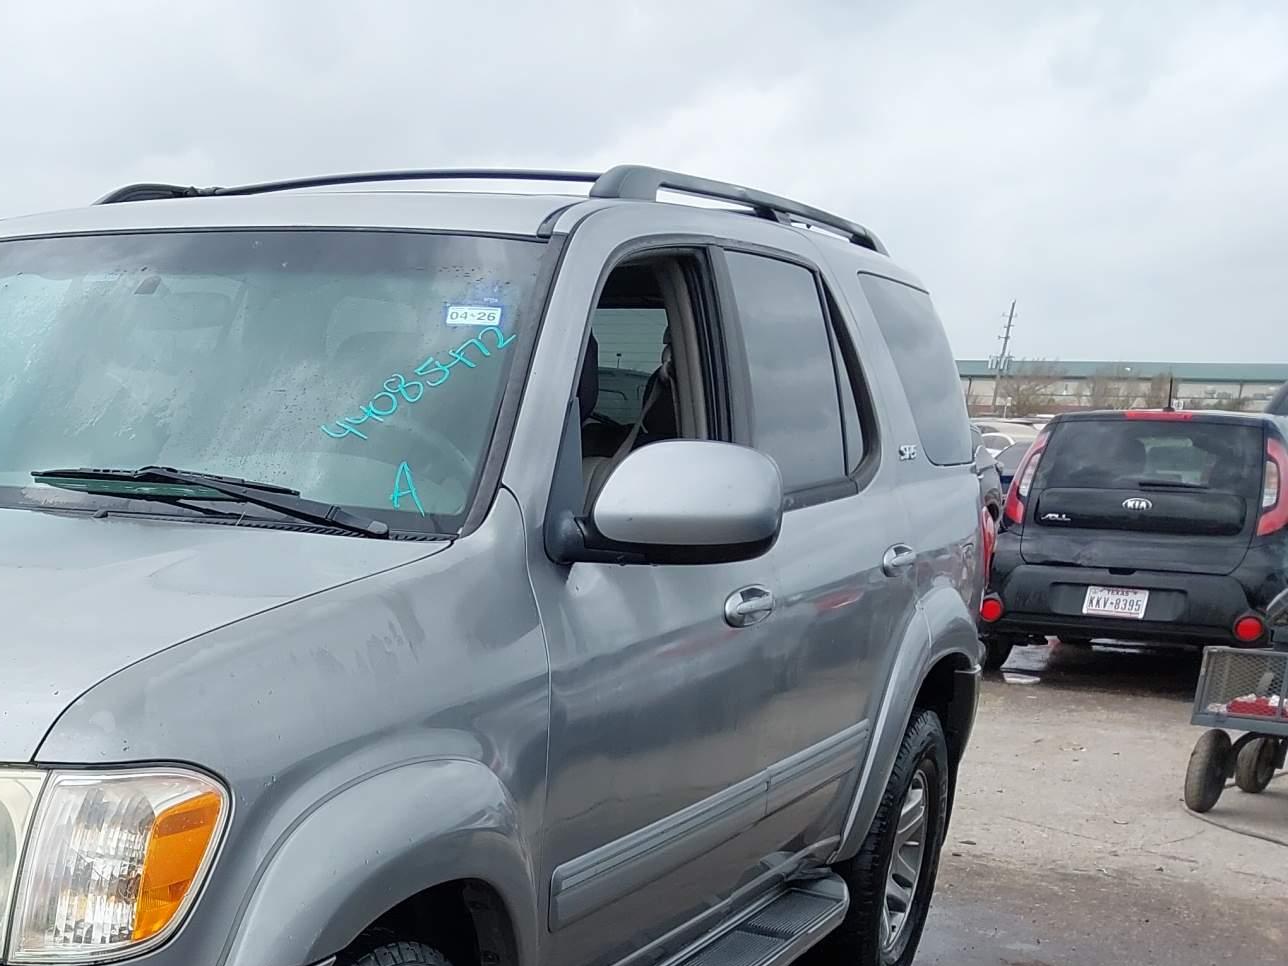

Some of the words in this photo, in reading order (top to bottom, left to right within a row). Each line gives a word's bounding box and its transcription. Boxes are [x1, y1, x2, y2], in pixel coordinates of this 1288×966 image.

[320, 326, 517, 440] 44085472
[389, 460, 425, 517] A
[1125, 499, 1149, 510] KIA
